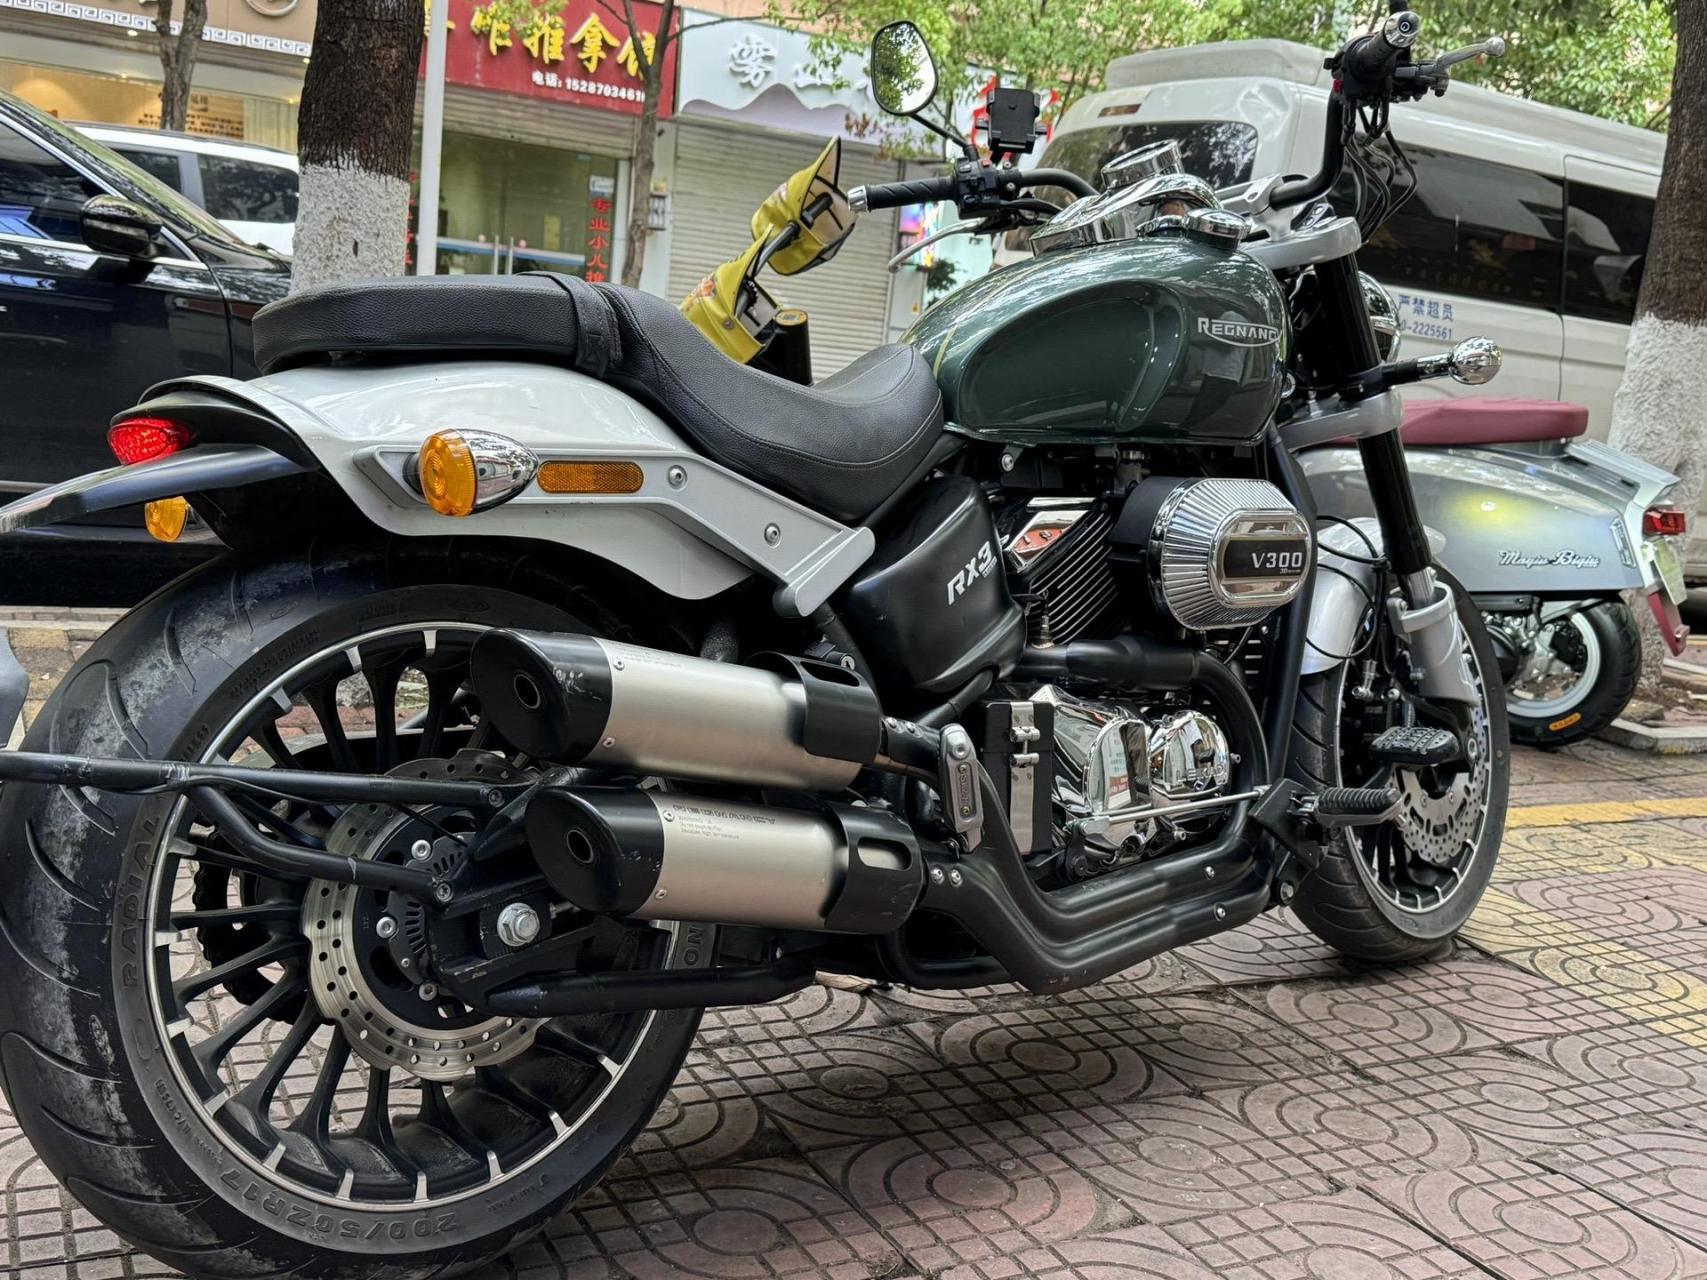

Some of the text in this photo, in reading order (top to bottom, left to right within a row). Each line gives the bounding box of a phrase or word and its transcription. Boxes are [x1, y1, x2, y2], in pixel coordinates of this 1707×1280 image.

[947, 541, 992, 606] RX3
[1251, 552, 1303, 569] V300
[121, 815, 160, 987] RADIAL
